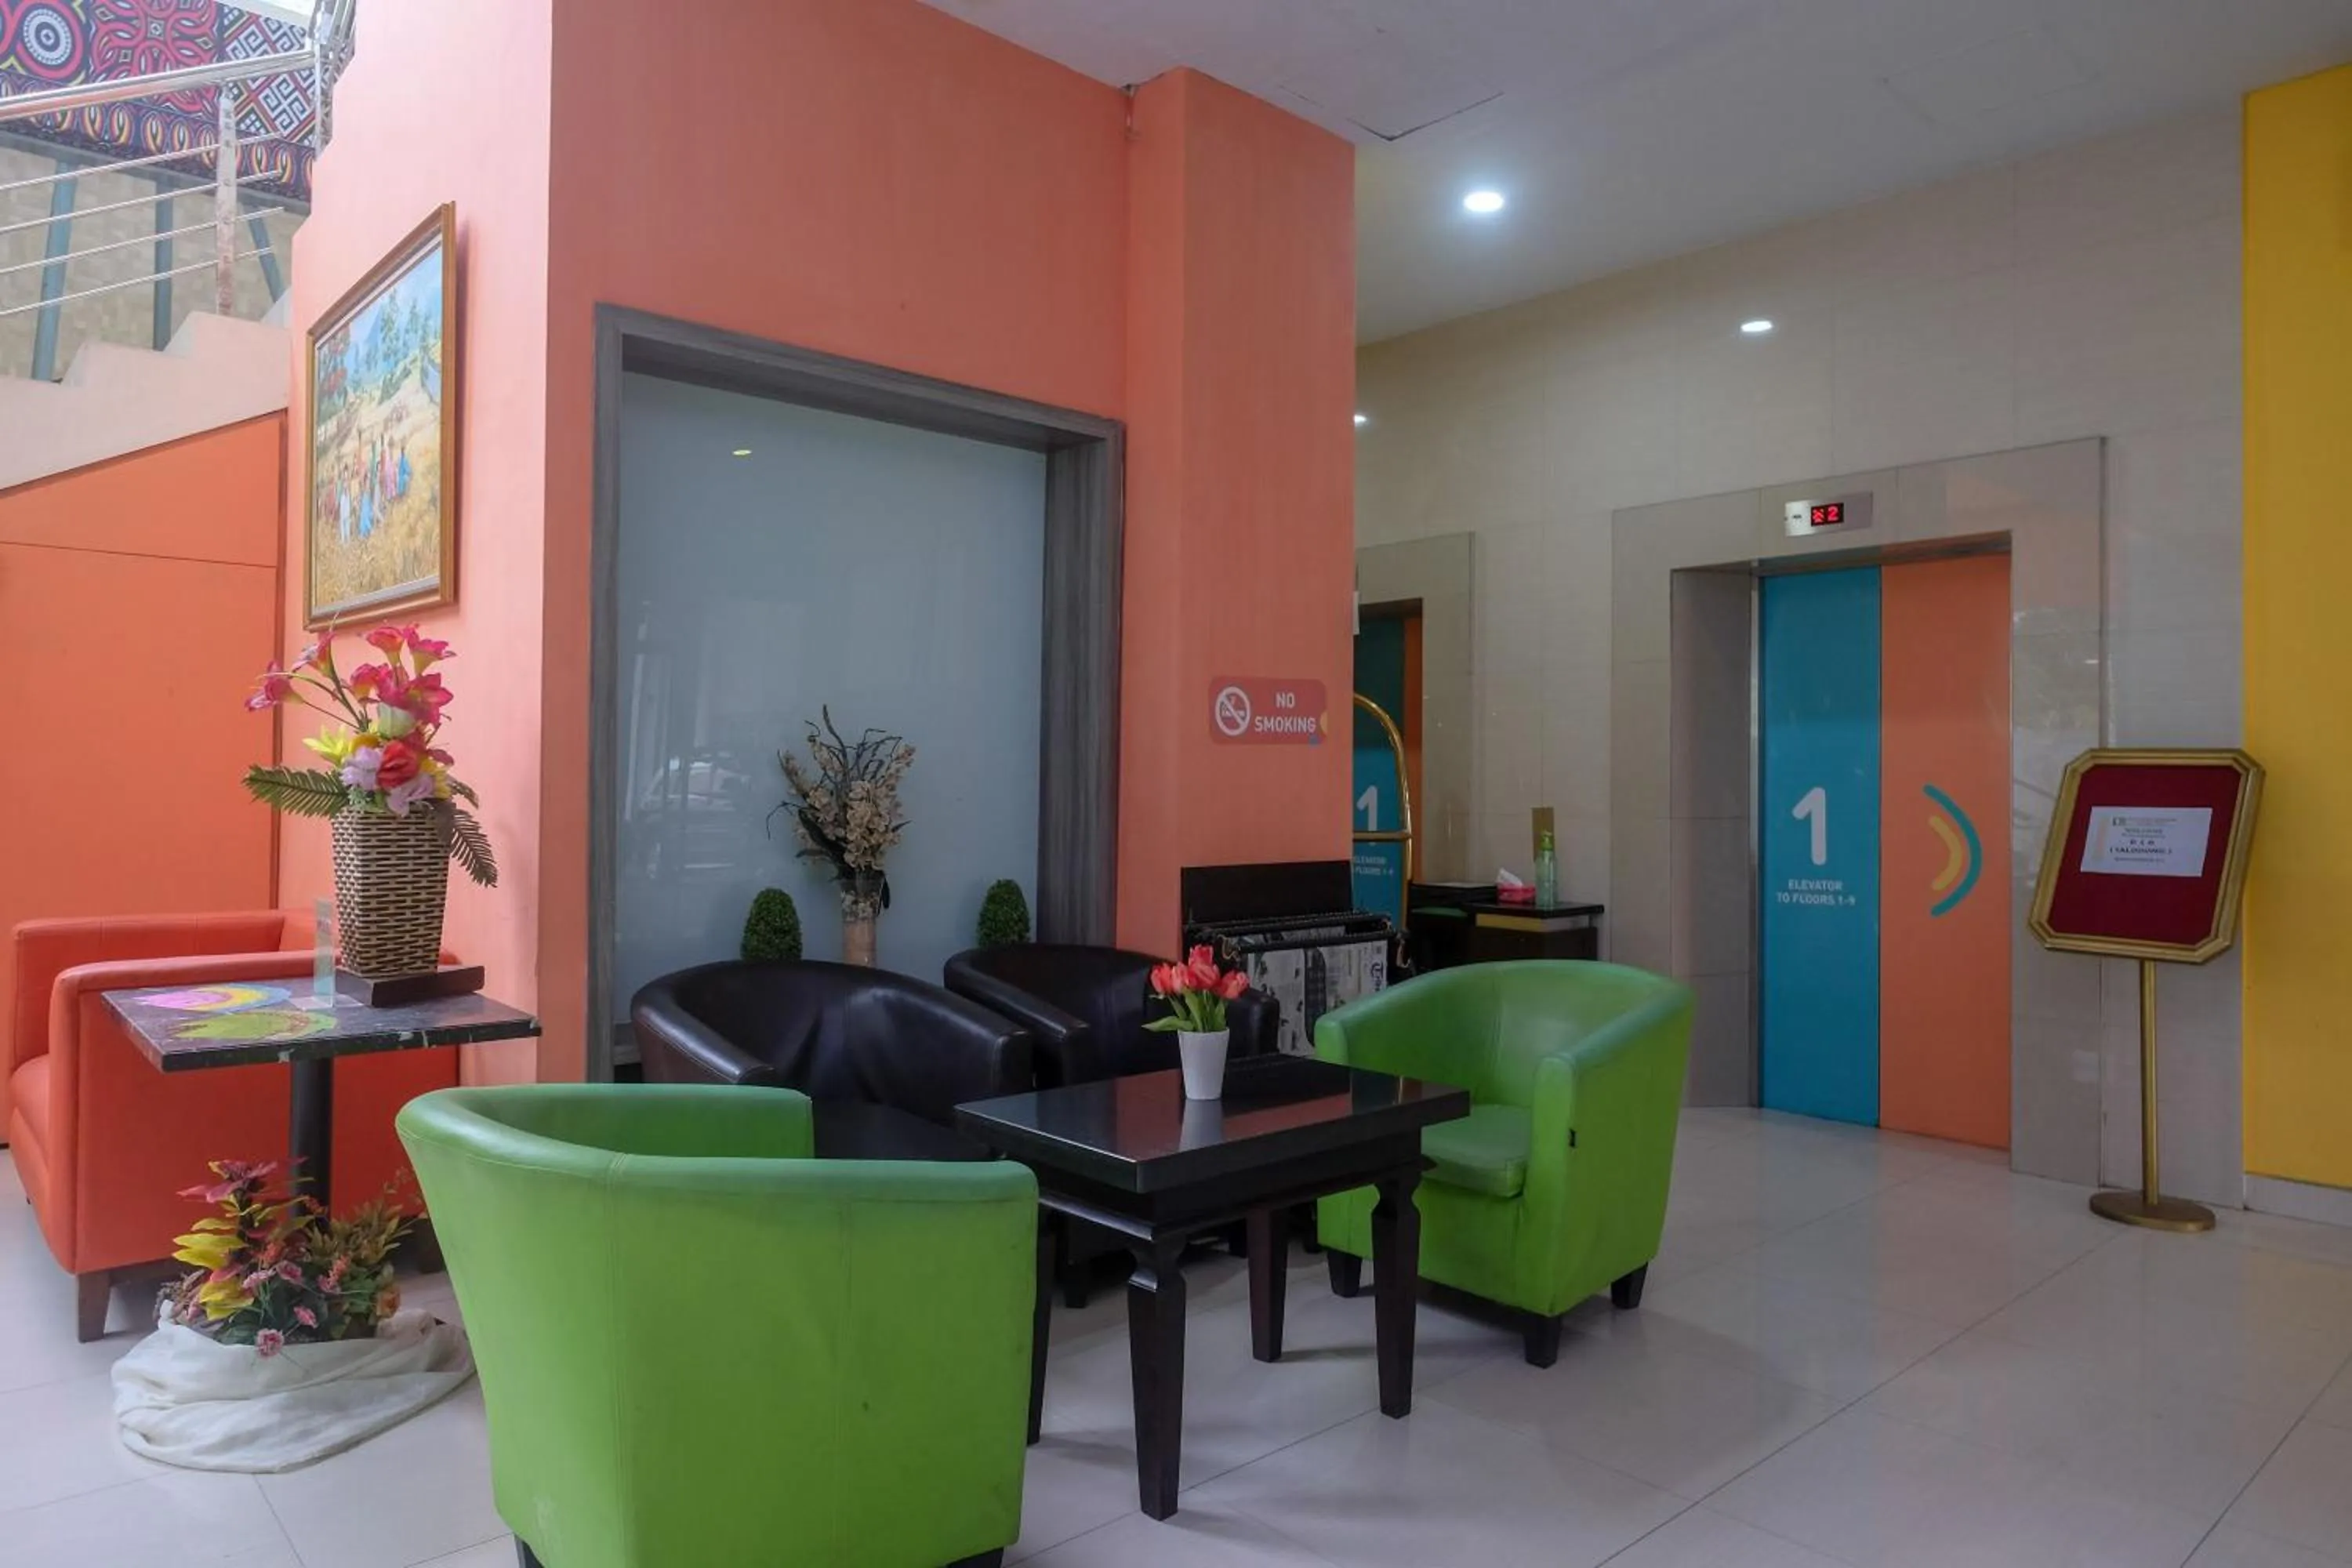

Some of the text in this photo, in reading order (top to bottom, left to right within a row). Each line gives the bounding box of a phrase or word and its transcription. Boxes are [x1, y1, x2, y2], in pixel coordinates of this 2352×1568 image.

[1828, 506, 1839, 522] 2
[1276, 691, 1295, 709] NO
[1254, 716, 1316, 733] SMOKING
[1356, 785, 1378, 846] 1
[1791, 786, 1827, 866] 1
[1788, 879, 1843, 891] ELEVATOR
[1777, 891, 1790, 903] TO
[1793, 892, 1835, 906] FLOORS
